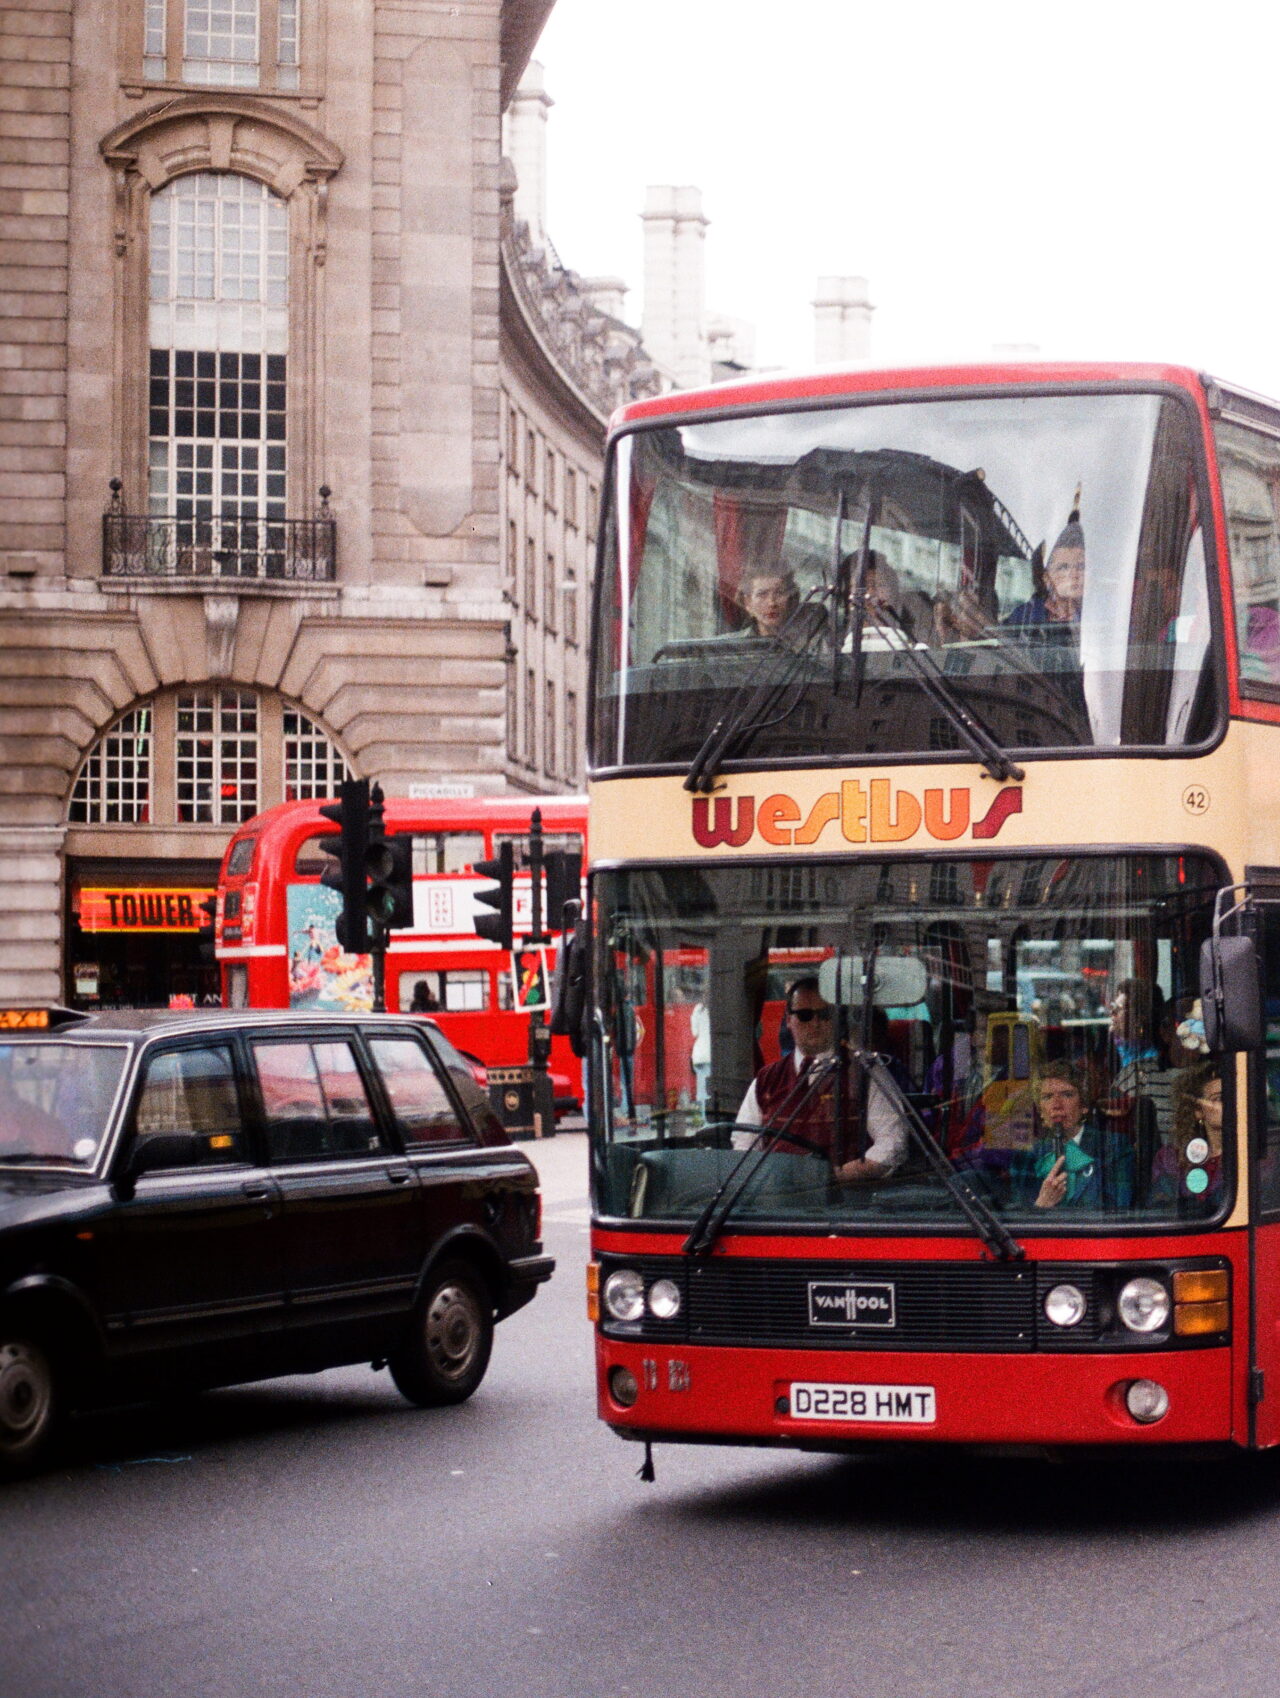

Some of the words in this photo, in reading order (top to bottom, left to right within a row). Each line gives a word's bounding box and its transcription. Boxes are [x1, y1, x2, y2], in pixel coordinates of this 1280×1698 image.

[692, 779, 1022, 848] westbus
[1186, 791, 1205, 809] 42
[105, 894, 195, 926] TOWER
[796, 1388, 867, 1416] D228
[875, 1391, 931, 1418] HMT
